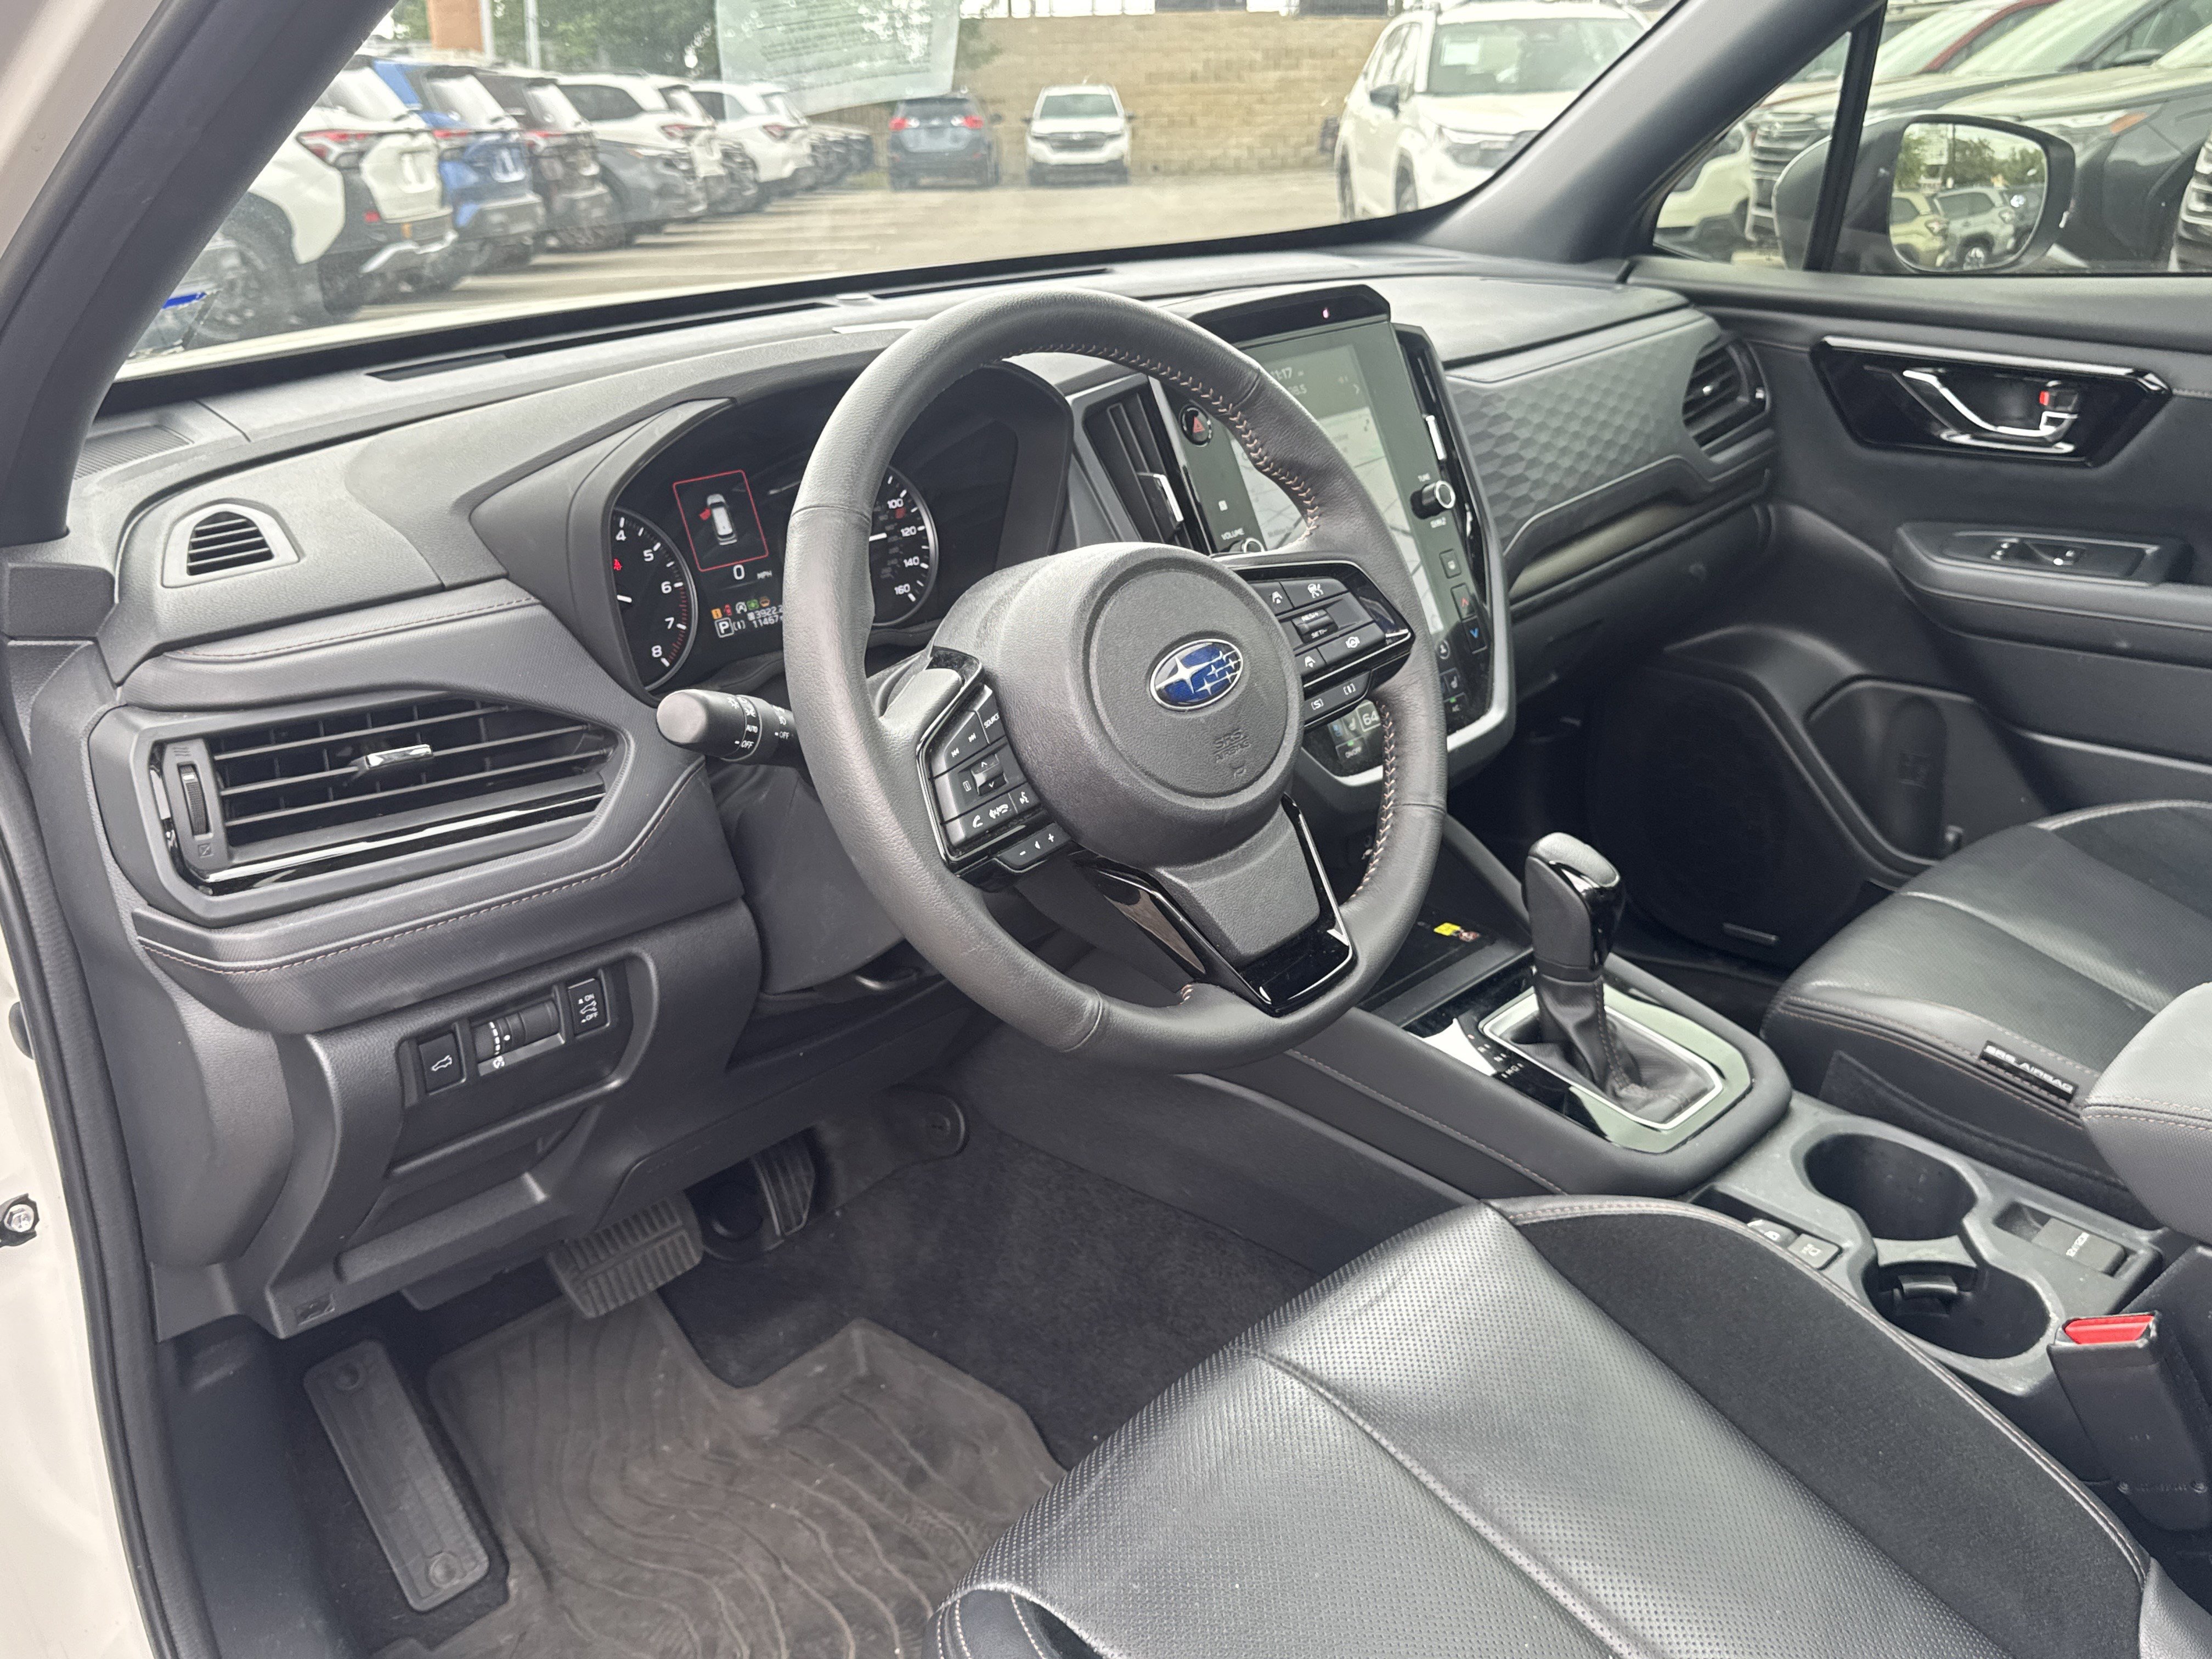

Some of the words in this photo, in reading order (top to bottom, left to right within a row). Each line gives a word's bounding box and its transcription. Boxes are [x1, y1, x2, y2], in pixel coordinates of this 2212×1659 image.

[887, 498, 904, 509] 100
[616, 529, 627, 541] 4
[901, 525, 917, 537] 120
[642, 549, 654, 562] 5
[904, 556, 919, 567] 140
[733, 564, 746, 580] 0
[661, 580, 672, 594] 6
[894, 583, 911, 595] 160
[664, 617, 674, 629] 7
[718, 621, 730, 634] P
[651, 645, 662, 658] 8
[1362, 710, 1379, 726] 64
[779, 731, 789, 740] OFF
[1213, 728, 1245, 749] SRS
[741, 740, 754, 749] OFF
[1215, 738, 1251, 763] AIRBAG
[1985, 1045, 2016, 1065] SRS
[2019, 1062, 2073, 1094] AIRBAG
